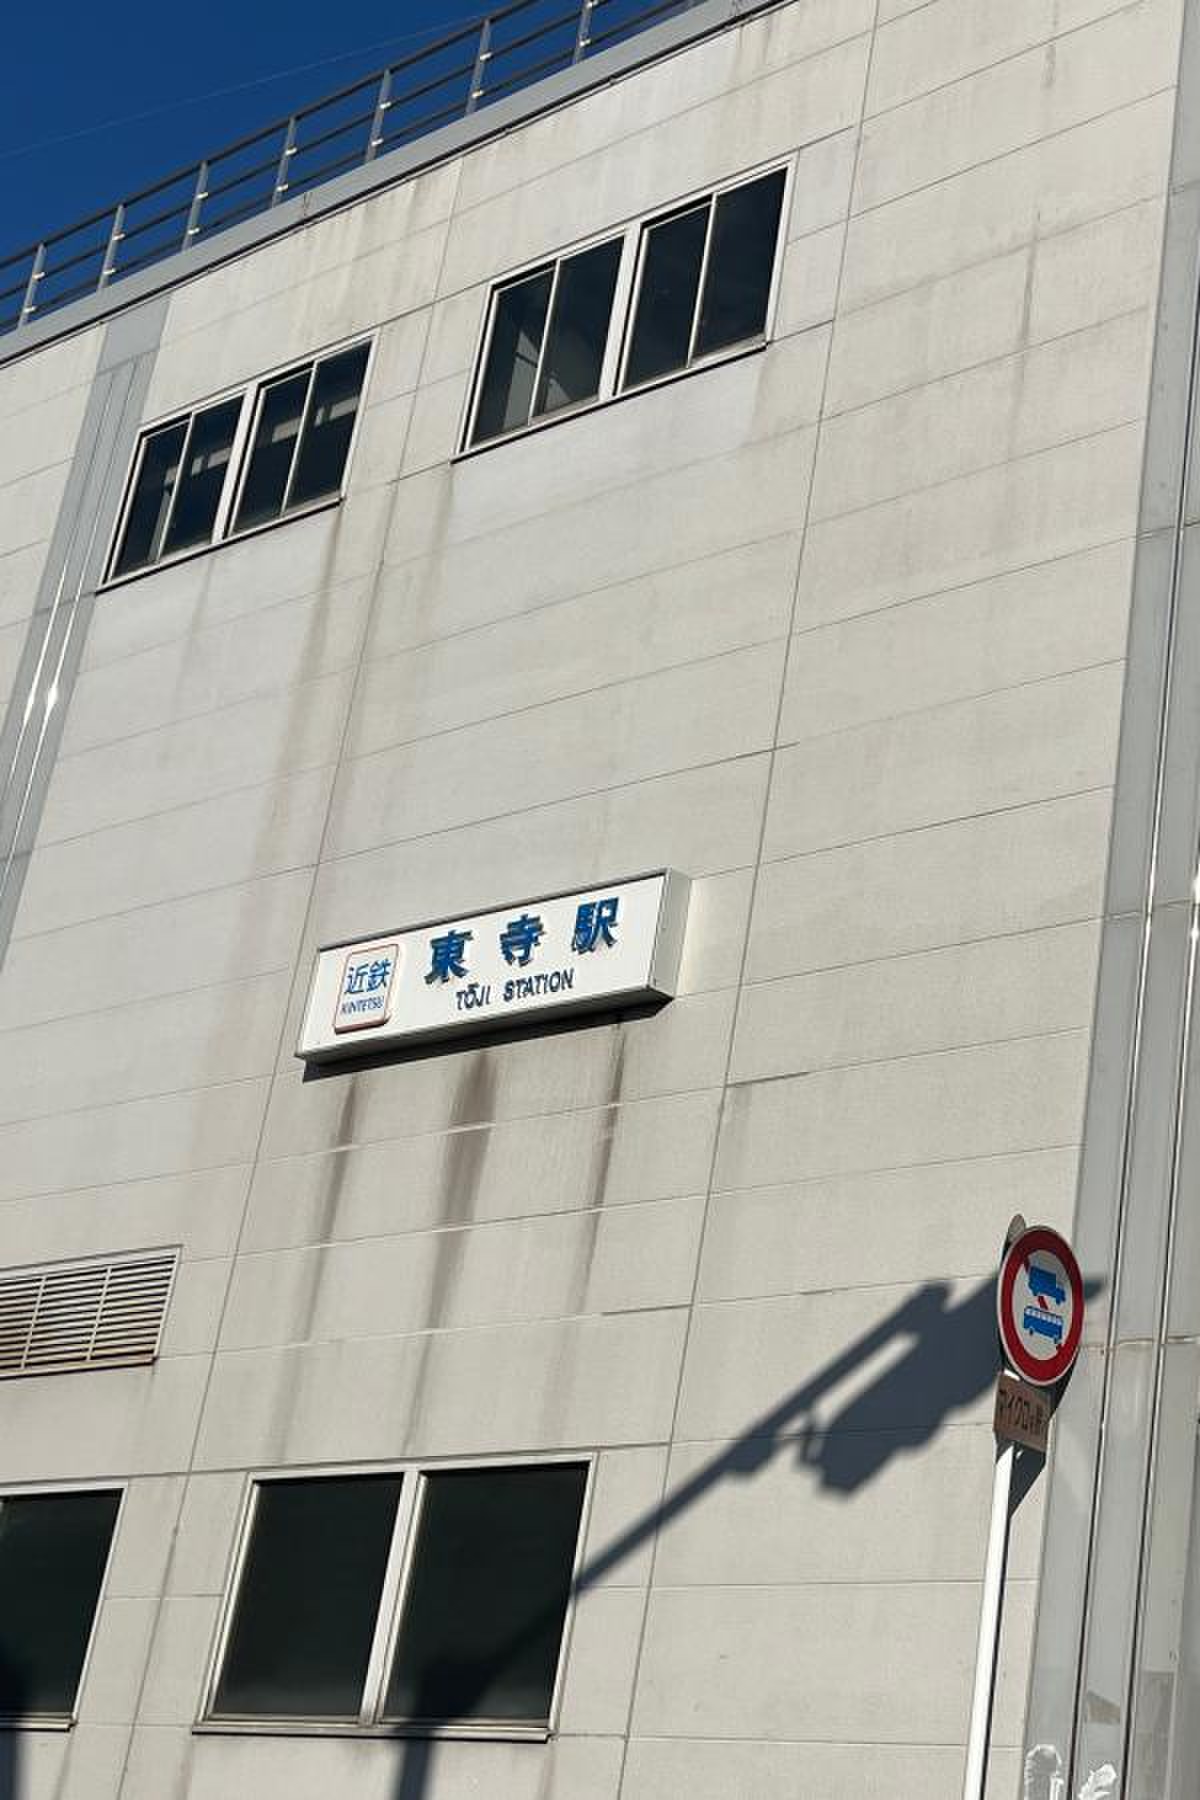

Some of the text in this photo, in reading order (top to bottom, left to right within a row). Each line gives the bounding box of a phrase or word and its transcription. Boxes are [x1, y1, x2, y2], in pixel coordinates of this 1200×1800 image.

[424, 896, 619, 985] 東寺駅
[344, 958, 391, 994] 近鉄
[503, 967, 575, 1002] STATION
